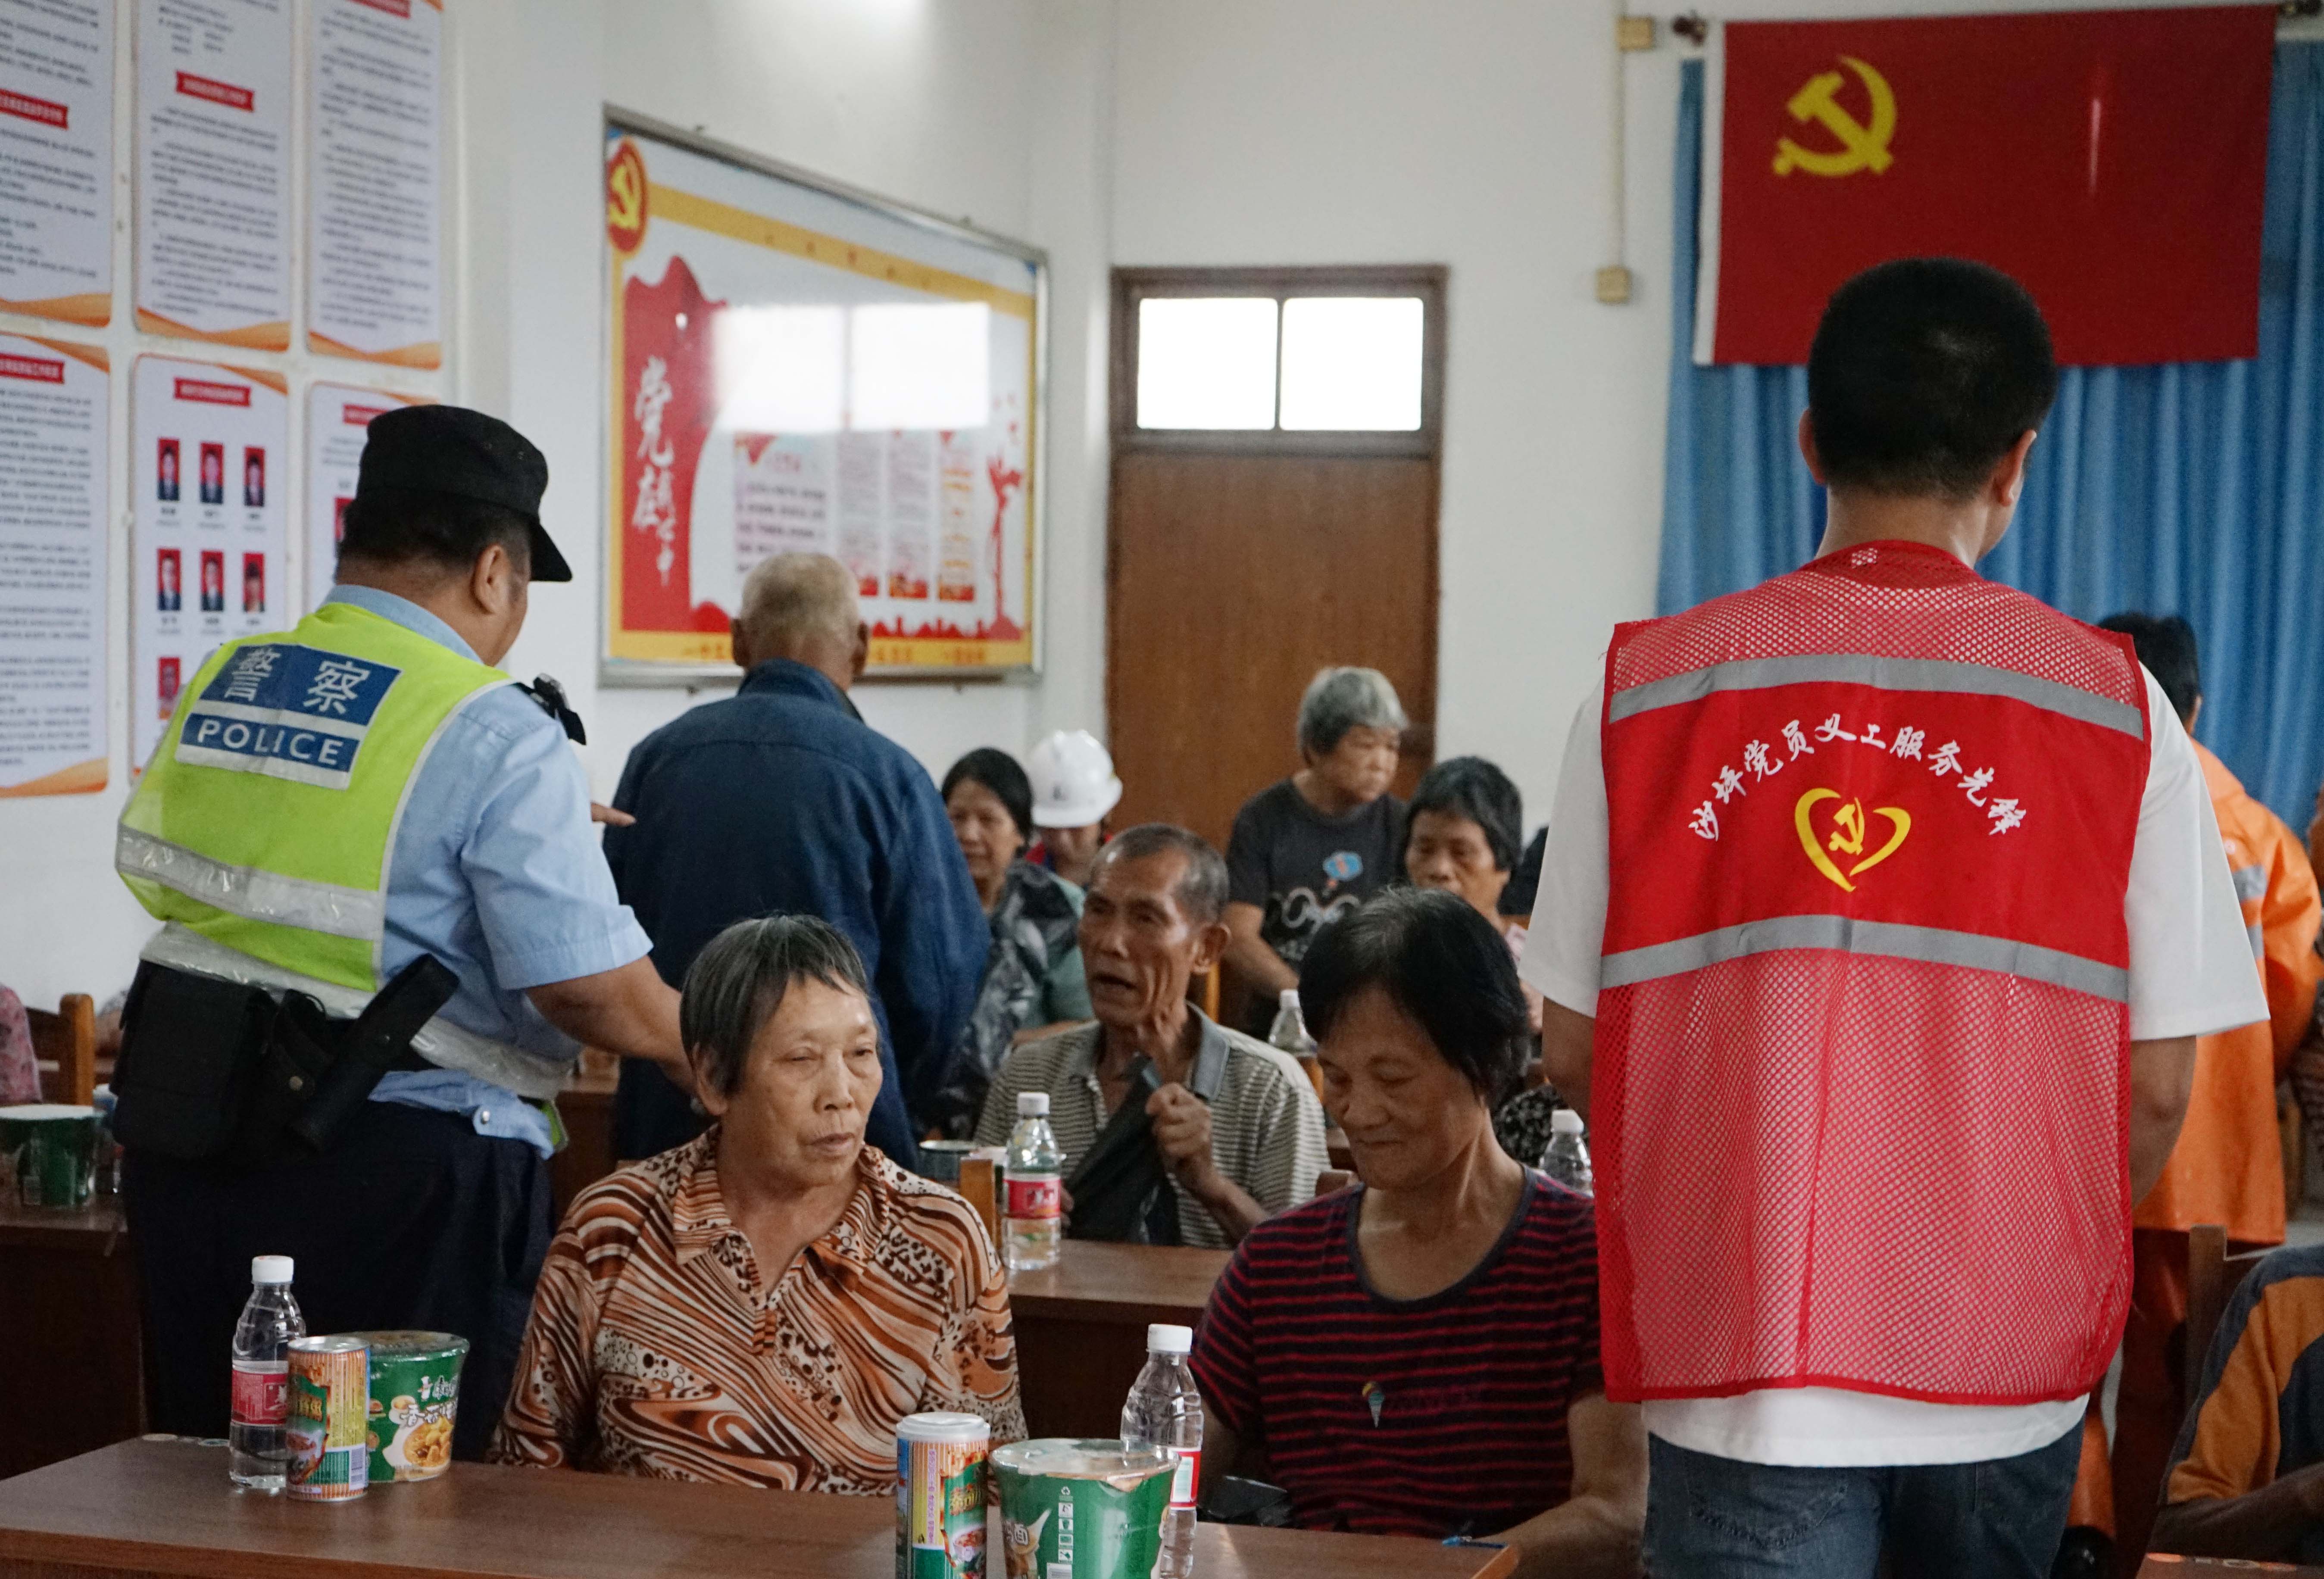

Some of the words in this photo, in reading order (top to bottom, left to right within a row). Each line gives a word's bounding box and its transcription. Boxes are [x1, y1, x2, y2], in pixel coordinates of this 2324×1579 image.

[225, 648, 370, 714] 警察
[197, 720, 343, 765] POLICE
[1688, 713, 2026, 842] 沙坪党员义工服务先锋
